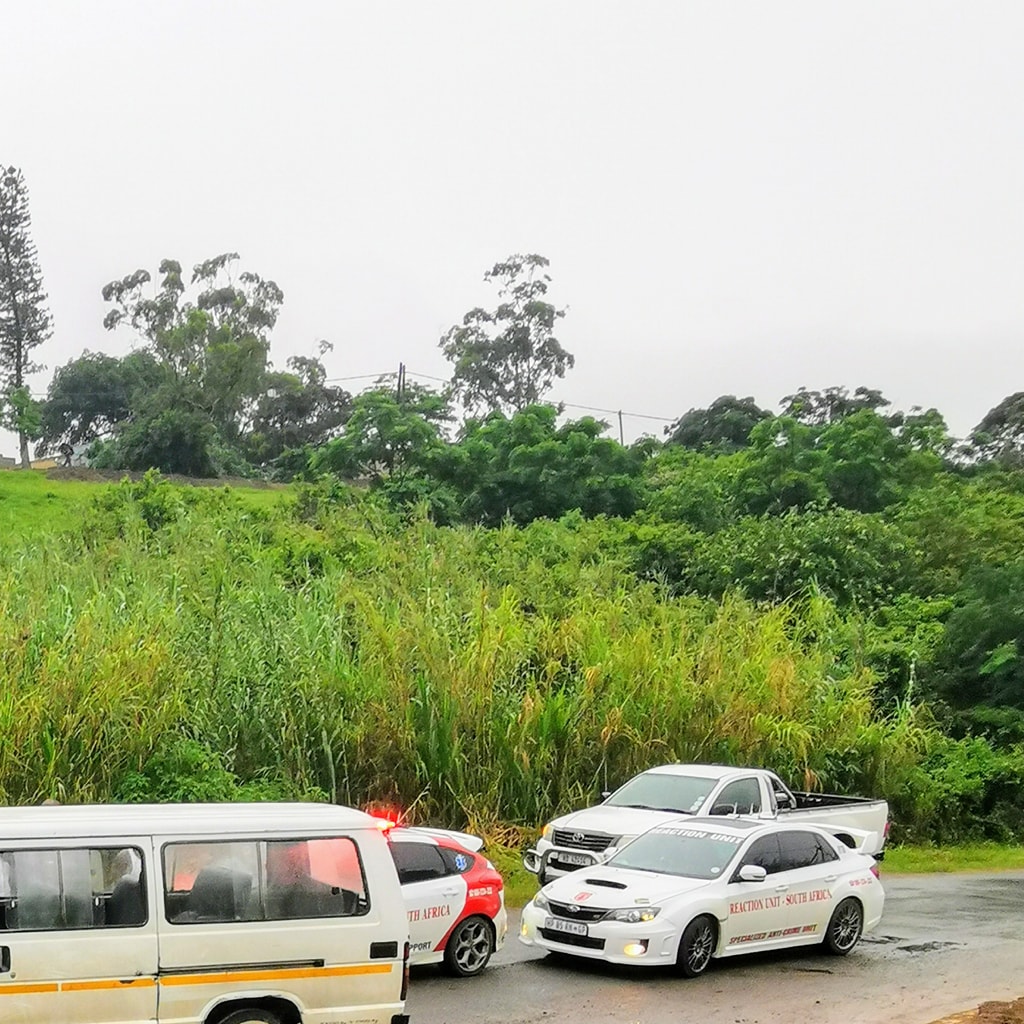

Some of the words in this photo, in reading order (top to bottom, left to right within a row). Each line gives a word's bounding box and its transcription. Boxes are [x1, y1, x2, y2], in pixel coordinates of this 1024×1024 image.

[710, 834, 744, 844] UNIT
[729, 898, 763, 914] REACTION
[765, 896, 781, 910] UNIT
[785, 892, 808, 906] SOUTH
[809, 889, 833, 902] AFRICA
[422, 904, 451, 920] AFRICA
